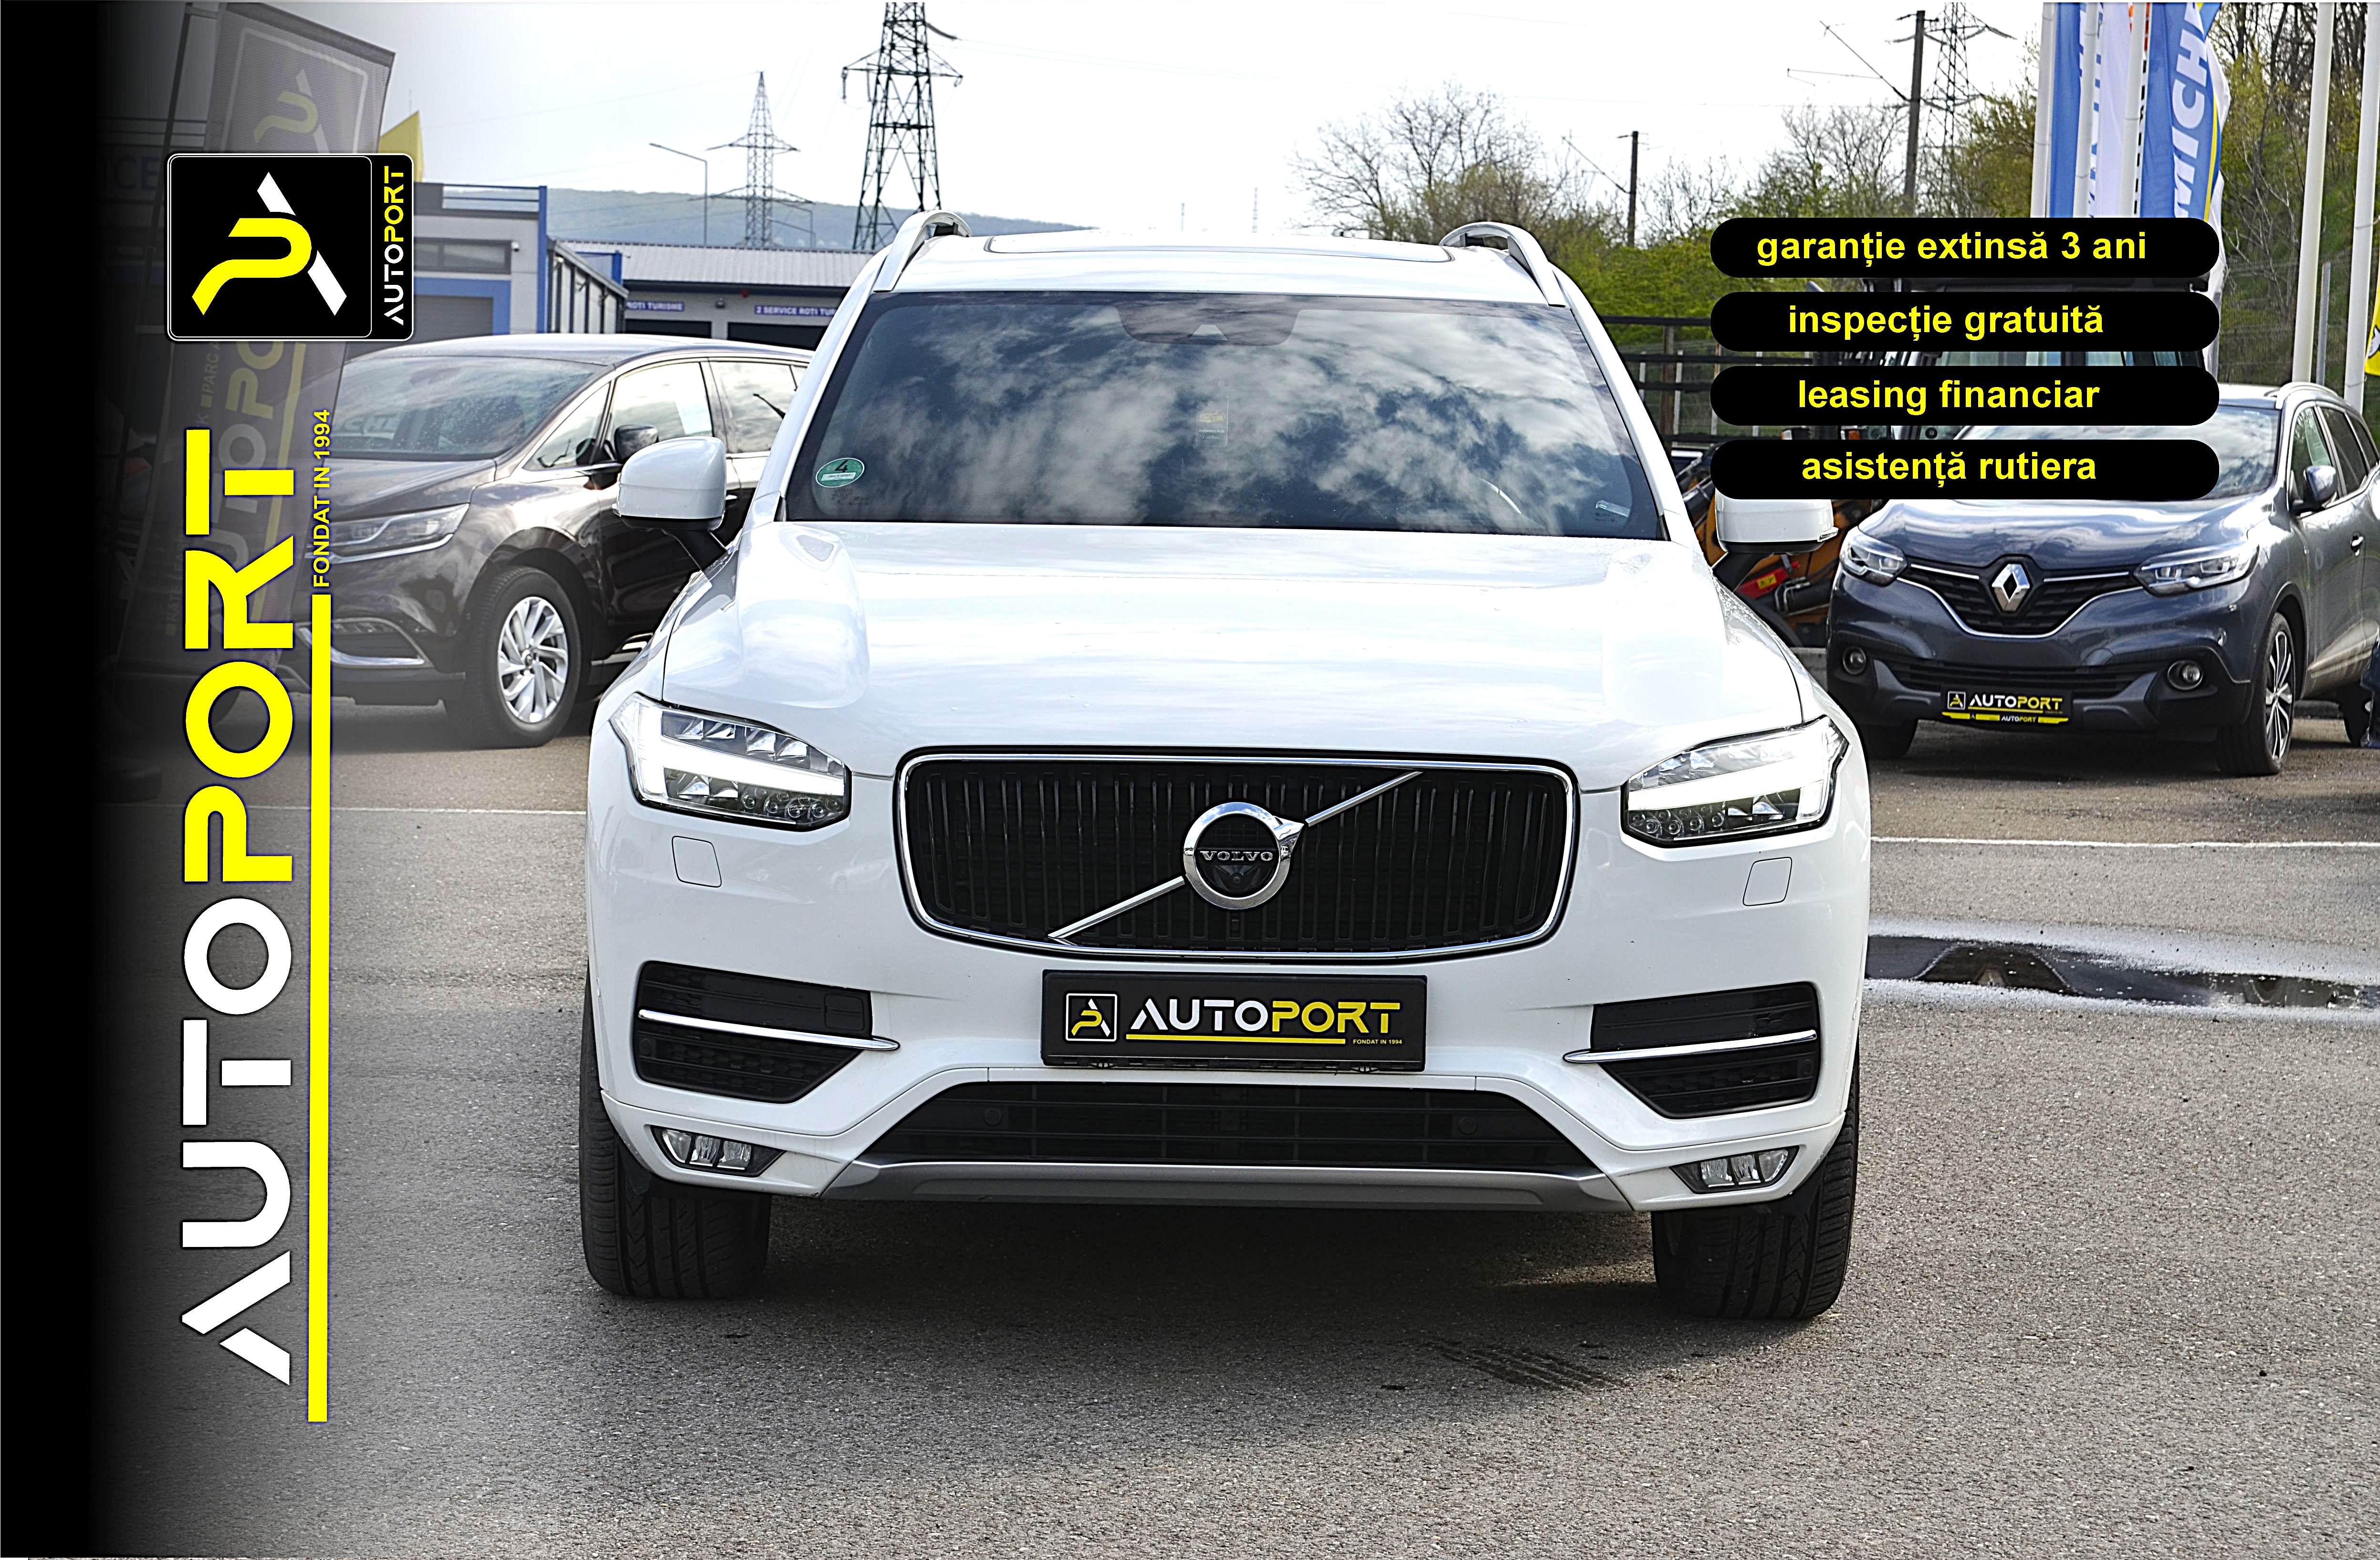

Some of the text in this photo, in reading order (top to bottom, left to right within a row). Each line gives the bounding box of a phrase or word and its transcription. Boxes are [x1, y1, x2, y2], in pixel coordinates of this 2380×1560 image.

[763, 306, 797, 315] SERVICE
[835, 460, 849, 472] 4
[1970, 693, 2063, 711] AUTOPORT
[1200, 851, 1273, 861] VOLVO
[1130, 998, 1401, 1033] AUTOPORT
